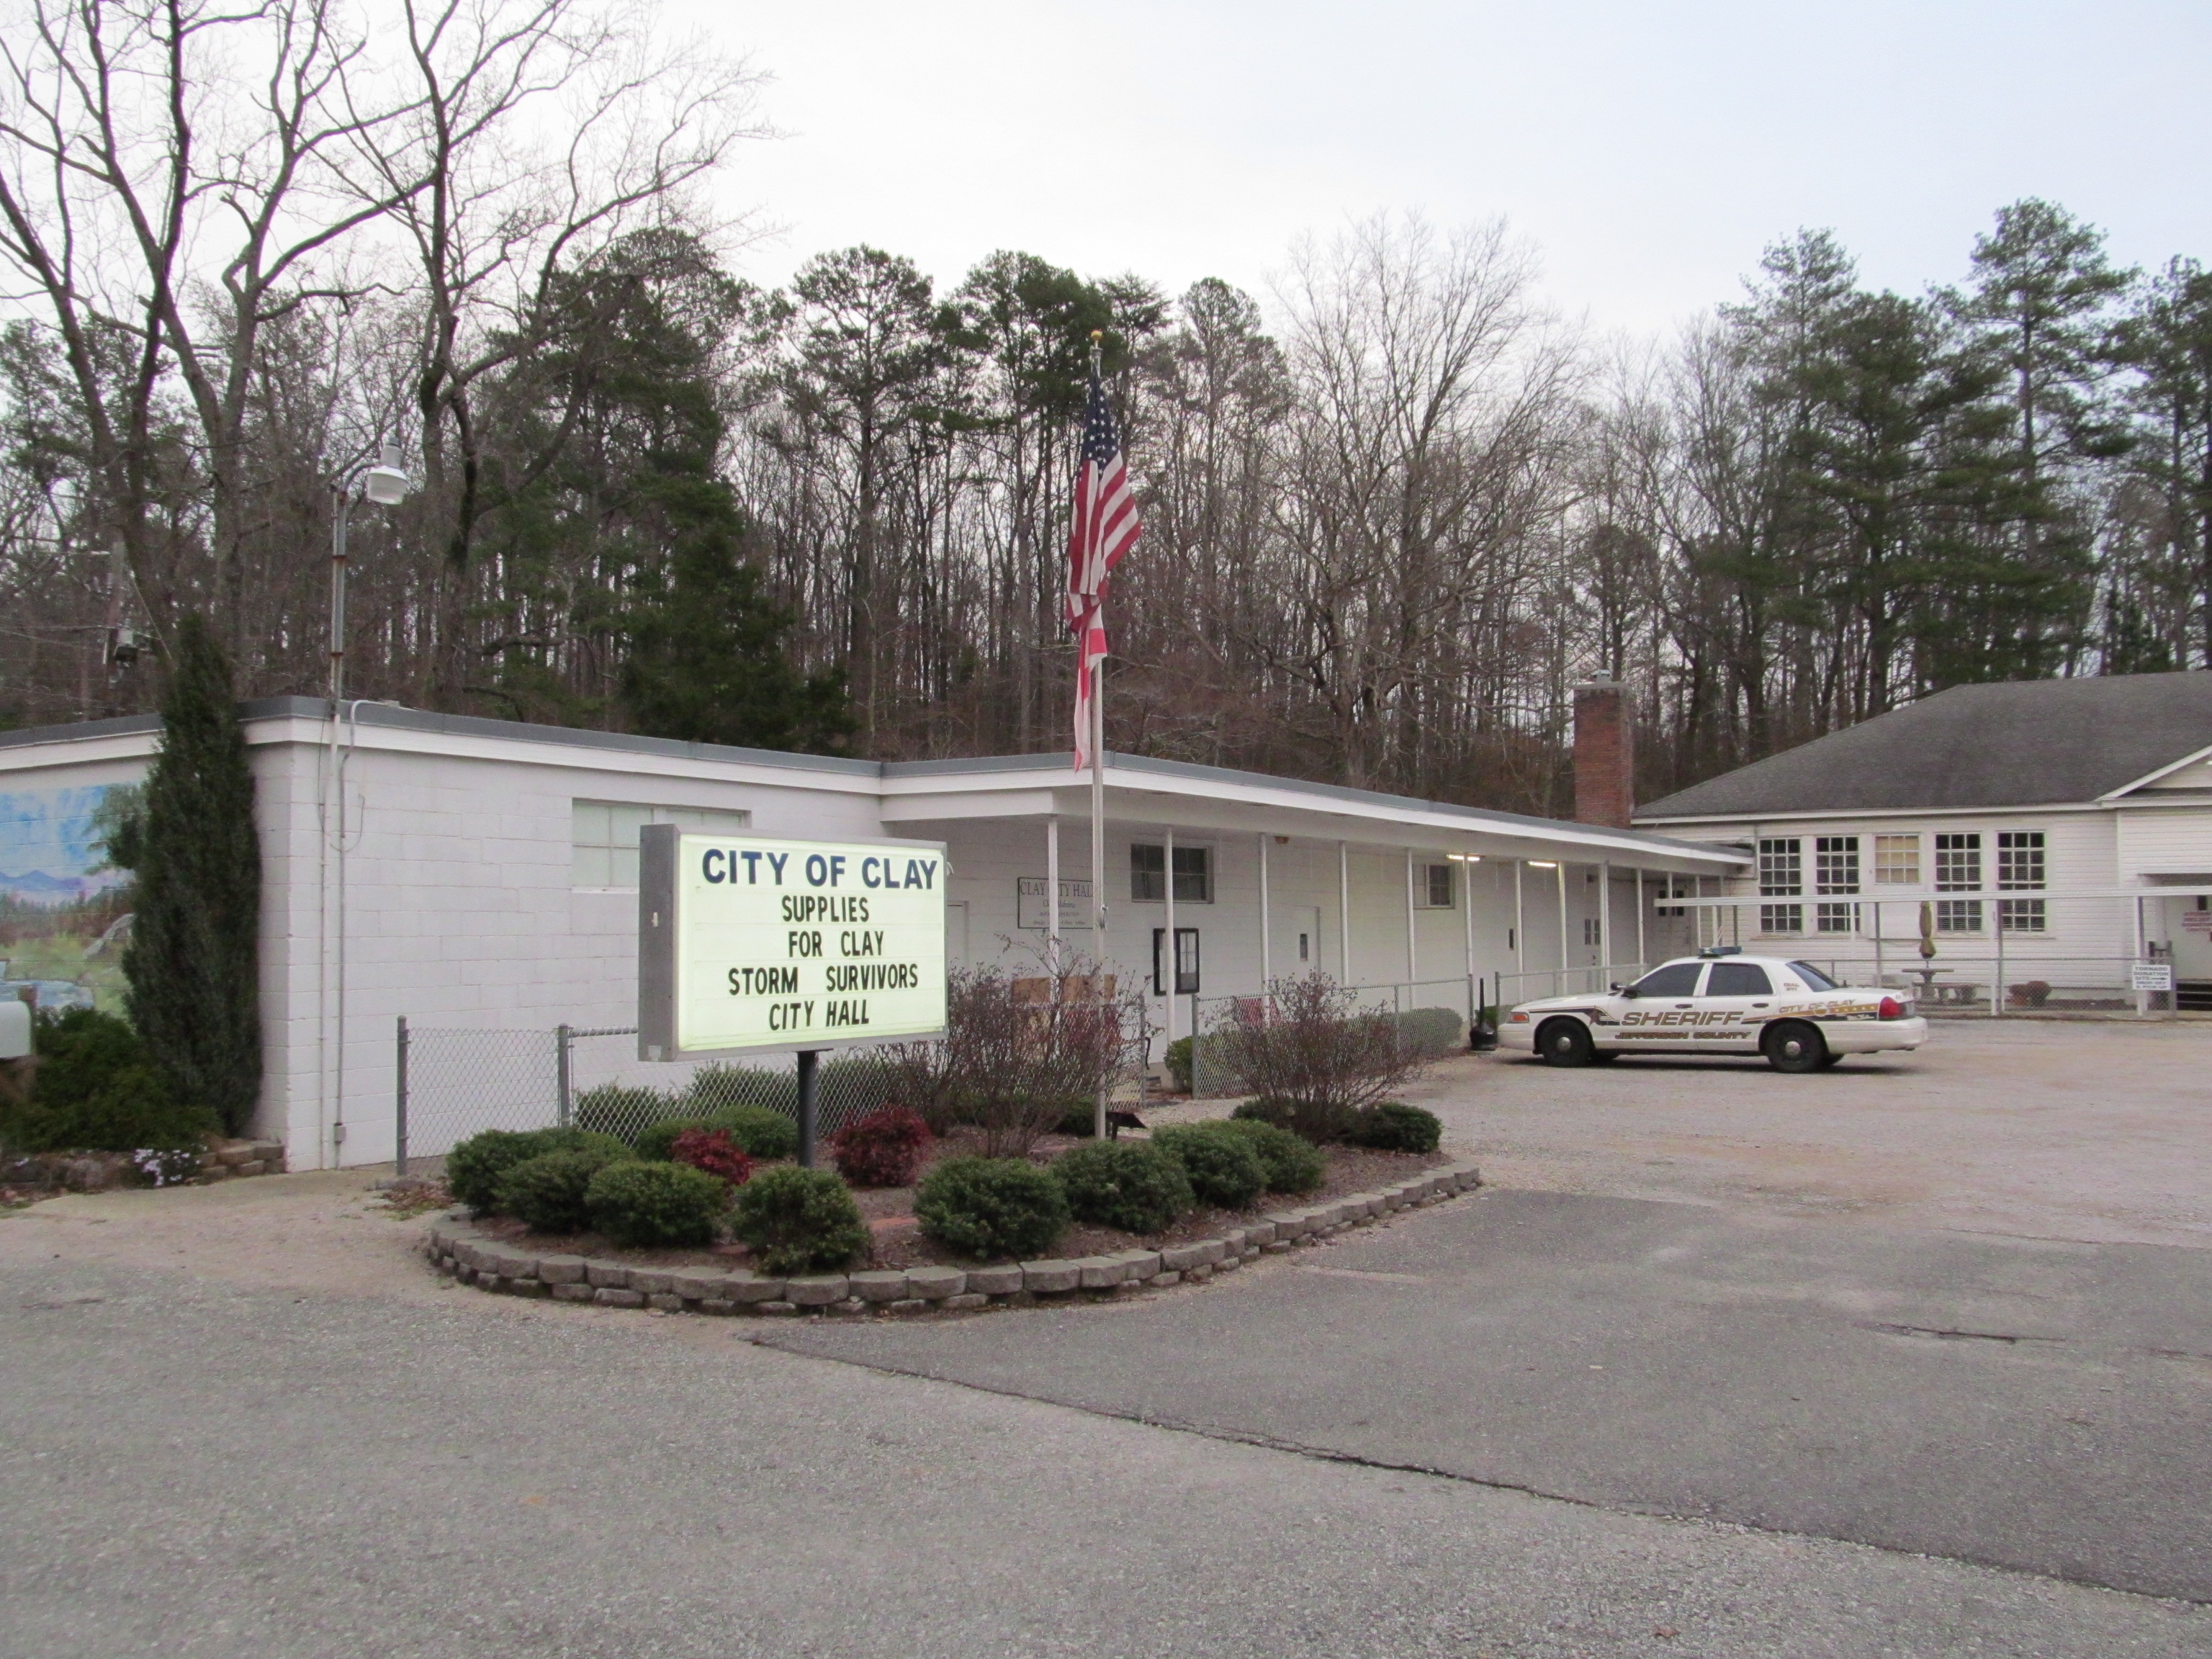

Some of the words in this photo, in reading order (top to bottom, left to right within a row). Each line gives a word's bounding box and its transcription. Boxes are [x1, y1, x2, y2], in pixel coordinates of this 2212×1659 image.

[702, 849, 788, 885] CITY
[806, 854, 845, 887] OF
[862, 857, 937, 889] CLAY
[1020, 882, 1046, 895] CLAY
[782, 895, 869, 922] SUPPLIES
[788, 931, 822, 958] FOR
[841, 930, 884, 958] CLAY
[728, 966, 798, 996] STORM
[826, 963, 918, 992] SURVIVORS
[769, 1000, 814, 1031] CITY
[826, 999, 869, 1027] HALL
[1621, 1011, 1744, 1026] SHERIFF
[1779, 1004, 1804, 1014] CITY
[1827, 999, 1856, 1007] CLAY
[1614, 1031, 1689, 1040] JEFFERSON
[1693, 1031, 1752, 1040] COUNTY
